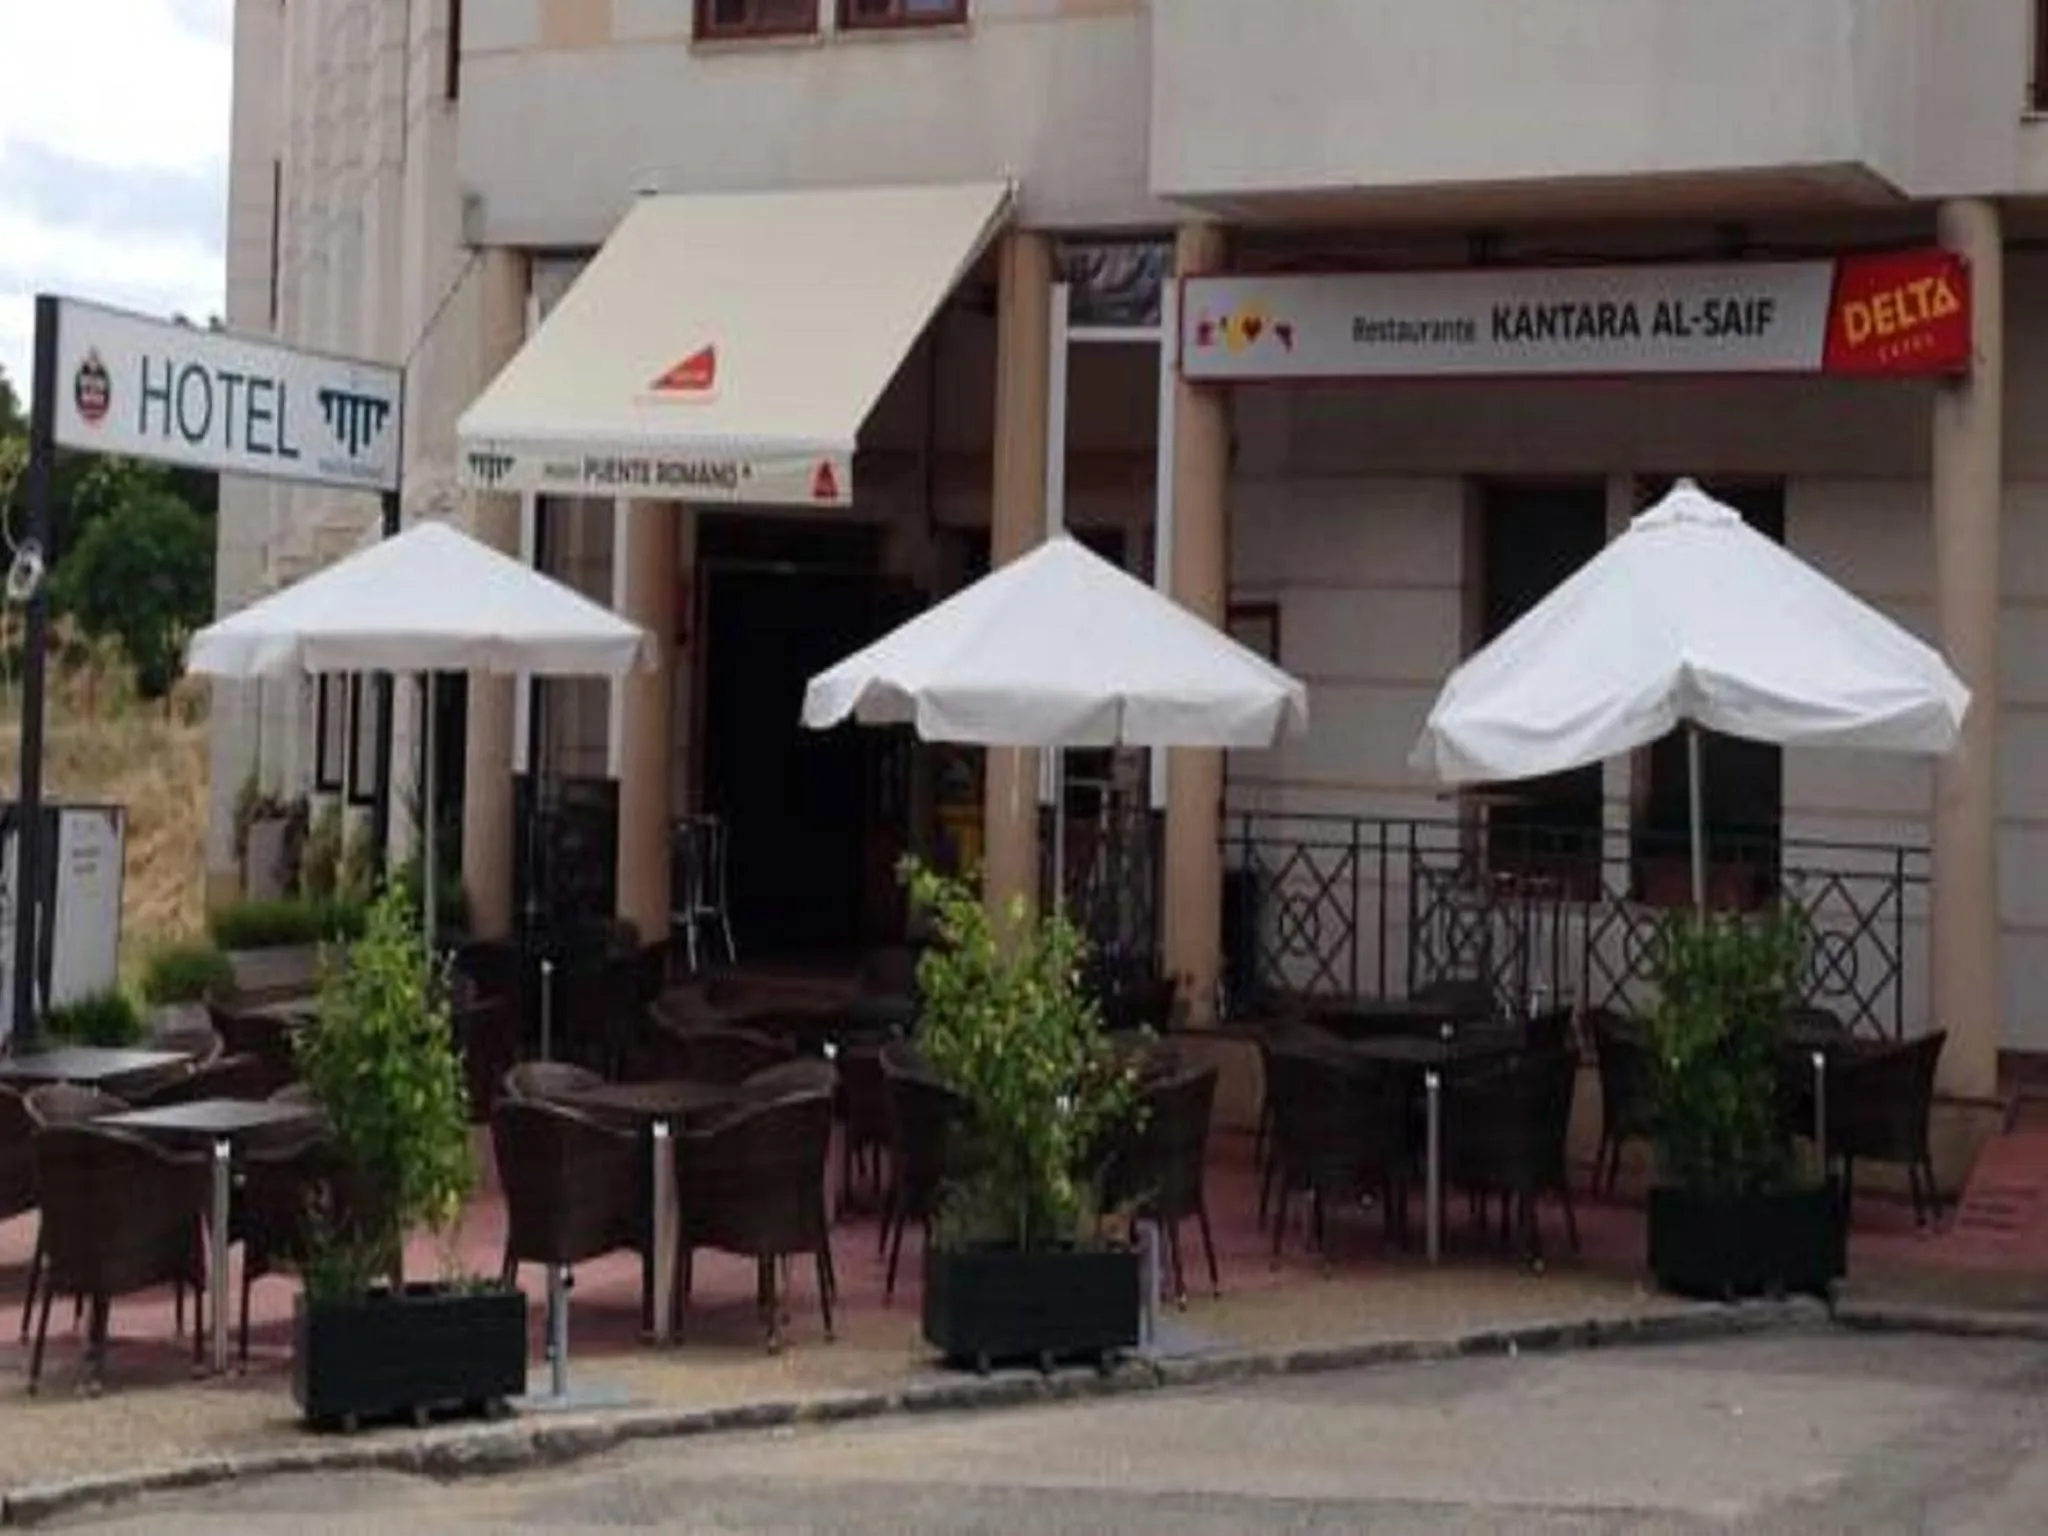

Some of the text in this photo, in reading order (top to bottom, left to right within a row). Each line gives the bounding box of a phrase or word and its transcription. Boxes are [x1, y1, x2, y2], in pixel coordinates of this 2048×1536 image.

[1353, 297, 1774, 344] Restaurante KANTARA AL-SAIF
[1843, 276, 1959, 348] DELTA
[138, 354, 299, 459] HOTEL
